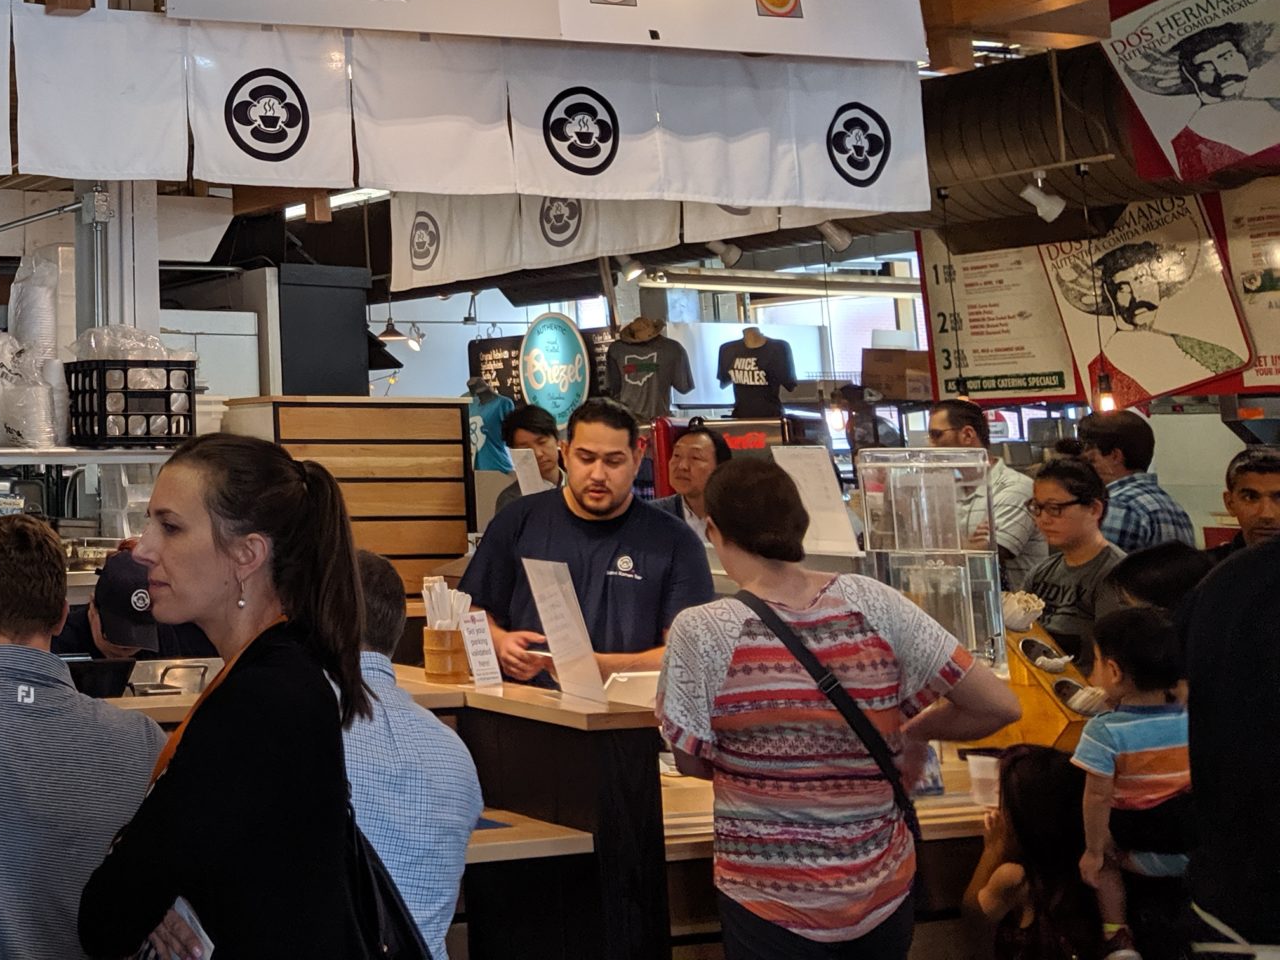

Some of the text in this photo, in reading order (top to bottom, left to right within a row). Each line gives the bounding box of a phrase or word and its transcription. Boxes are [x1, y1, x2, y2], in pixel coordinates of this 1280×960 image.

[1176, 12, 1222, 38] COMIDA
[1109, 26, 1155, 57] DOS
[1101, 229, 1141, 250] COMIDA
[1141, 206, 1192, 234] MEXICANA
[932, 264, 940, 285] 1
[937, 311, 949, 334] 2
[941, 348, 952, 370] 3
[982, 379, 997, 389] OUR
[997, 377, 1027, 388] CATERING
[1027, 375, 1058, 386] SPECIALS!
[17, 684, 35, 704] FJ
